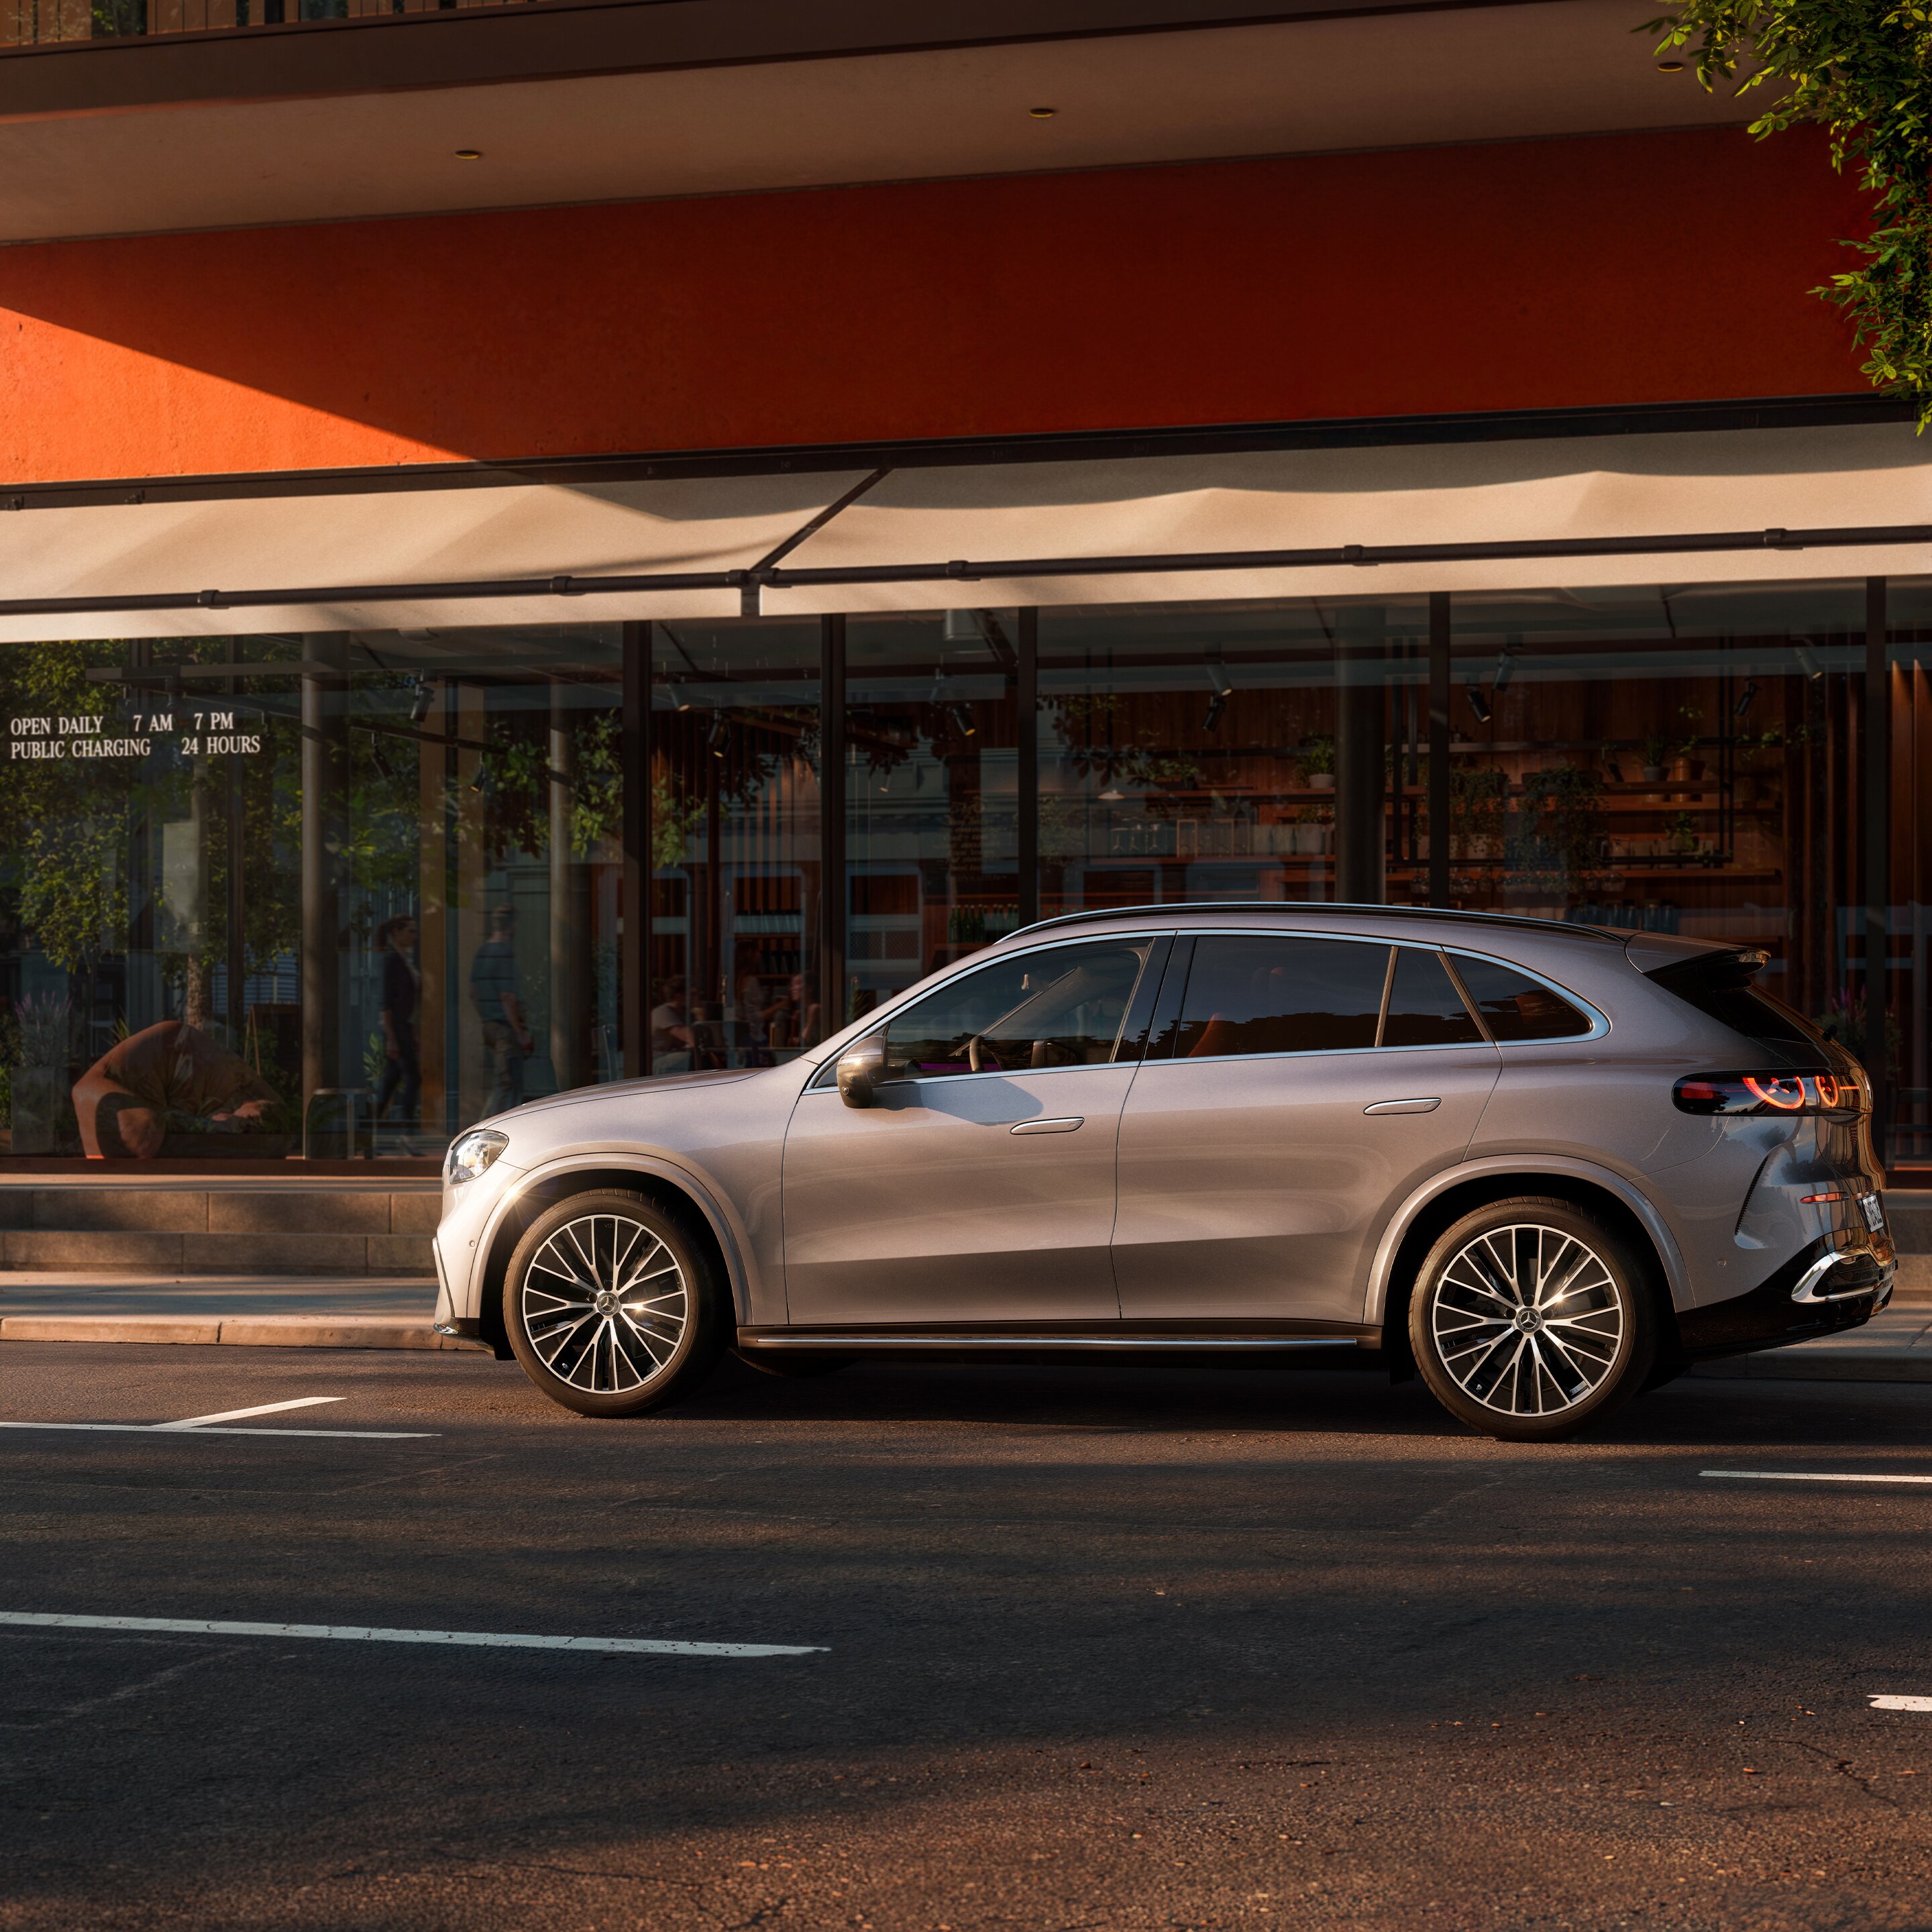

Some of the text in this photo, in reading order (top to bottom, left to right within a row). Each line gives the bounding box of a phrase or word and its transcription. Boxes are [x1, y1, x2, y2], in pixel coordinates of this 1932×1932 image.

[11, 712, 233, 735] OPEN DAILY 7 AM 7 PM
[11, 736, 260, 759] PUBLIC CHARGING 24 HOURS
